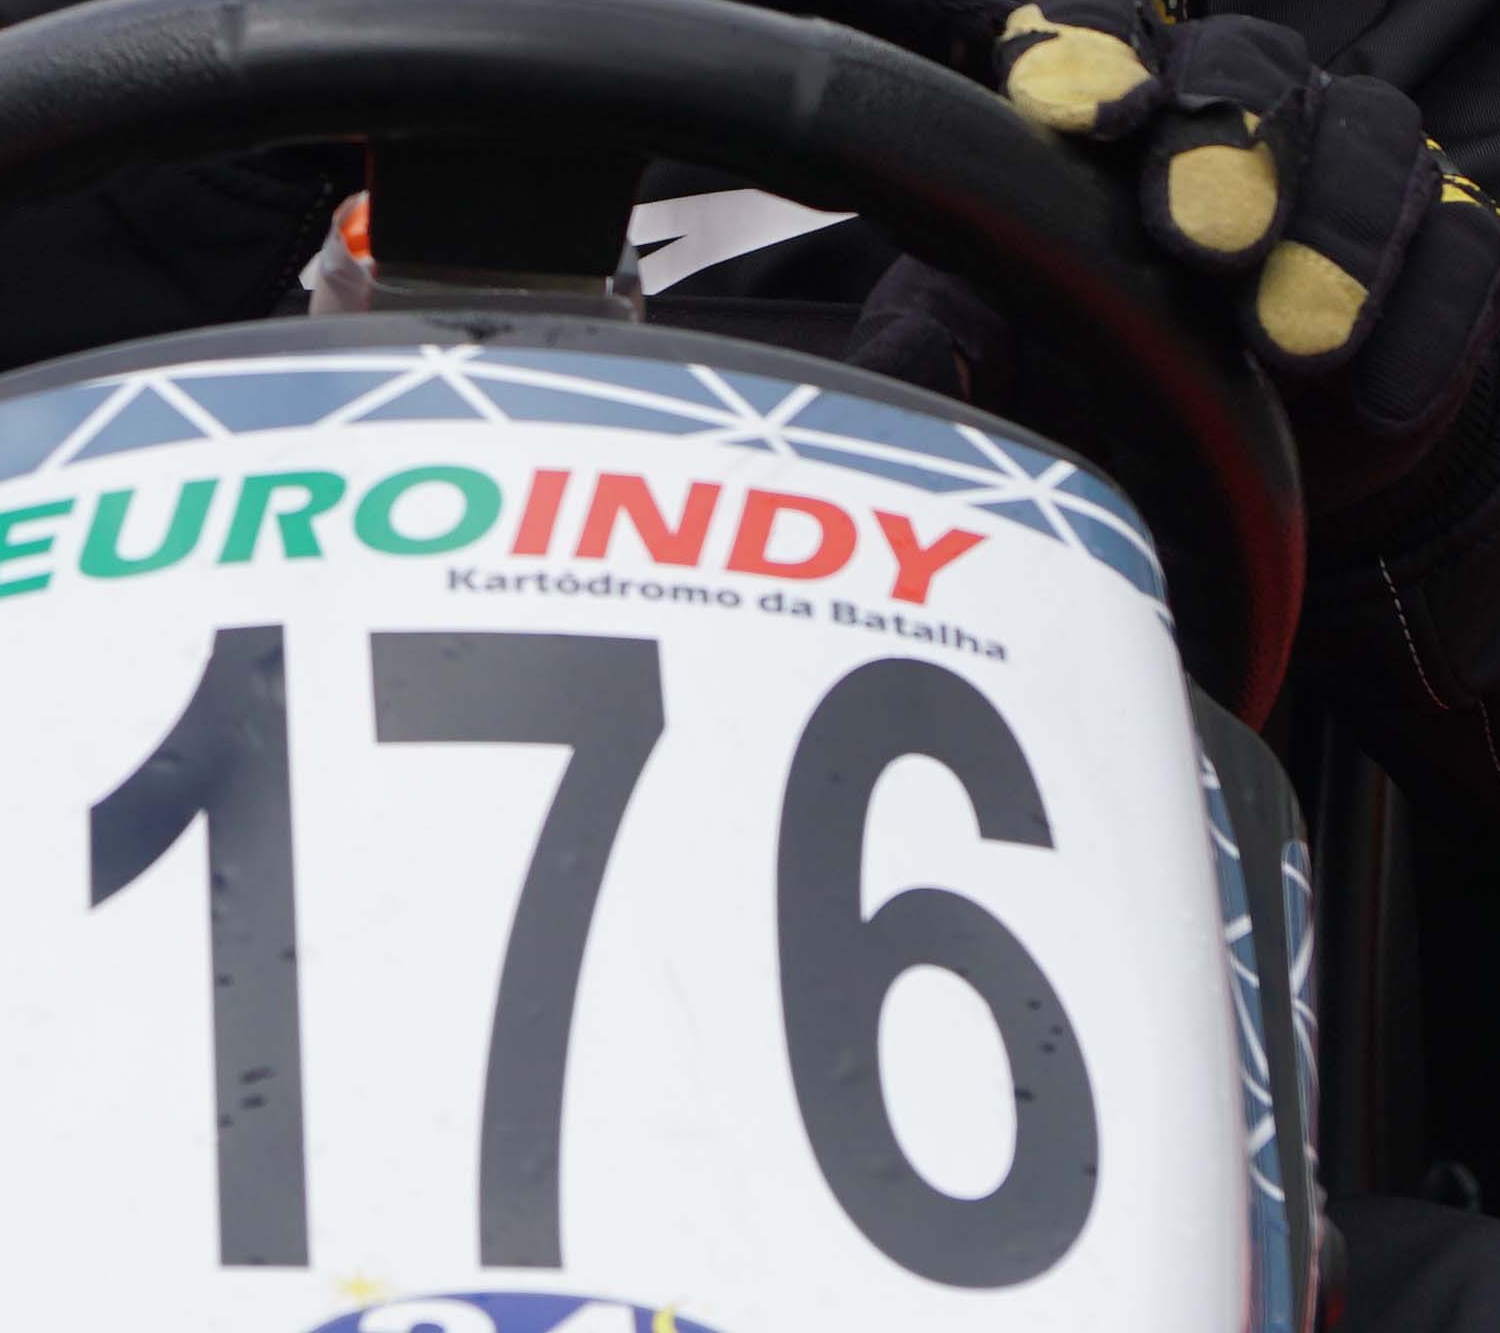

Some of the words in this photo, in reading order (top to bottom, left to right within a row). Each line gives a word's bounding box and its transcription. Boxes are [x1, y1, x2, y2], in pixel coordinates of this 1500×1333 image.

[446, 566, 743, 610] Kartódromo
[758, 589, 815, 621] da
[829, 600, 1009, 664] Batalha
[89, 624, 1100, 1290] 176
